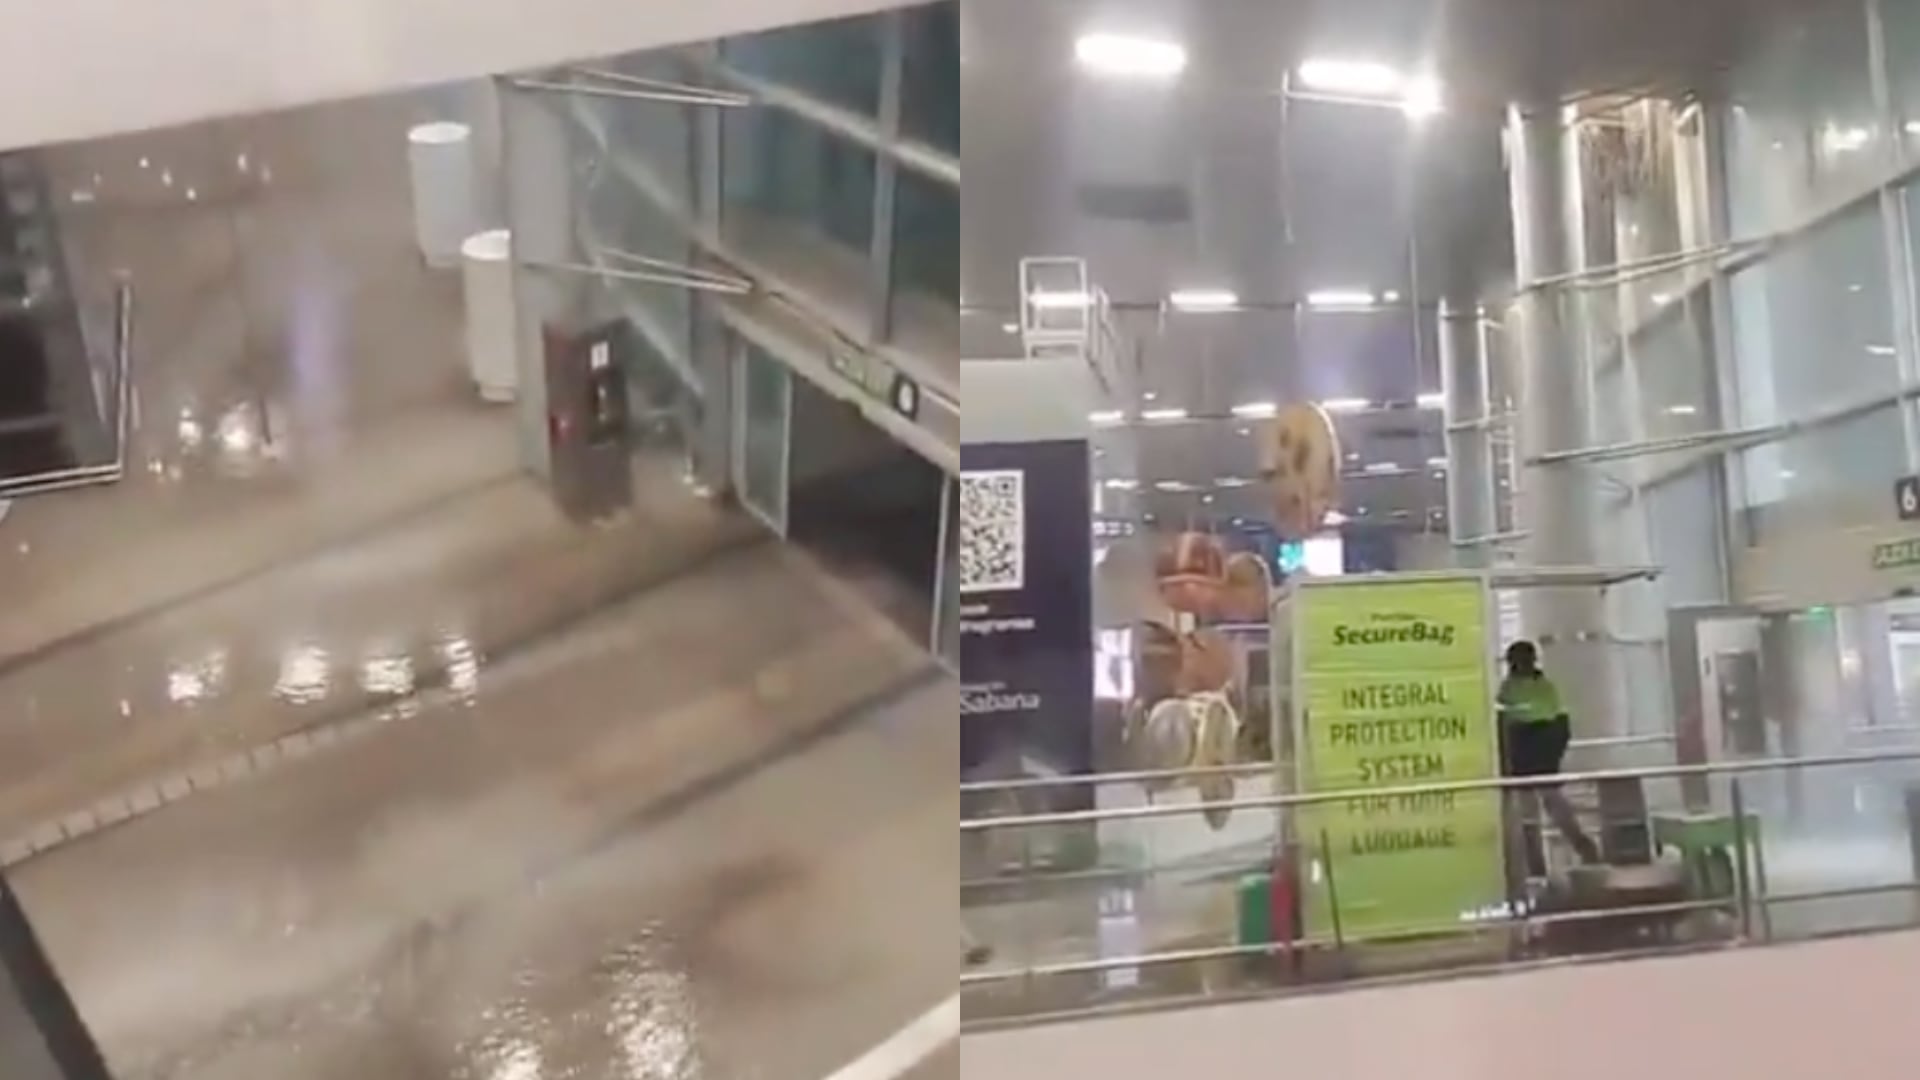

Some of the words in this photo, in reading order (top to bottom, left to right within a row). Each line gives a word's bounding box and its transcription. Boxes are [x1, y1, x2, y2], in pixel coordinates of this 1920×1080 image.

[1902, 485, 1917, 512] 6
[1332, 622, 1455, 646] SecureBag
[1342, 682, 1448, 710] INTEGRAL
[1330, 715, 1467, 746] PROTECTION
[1357, 752, 1444, 782] SYSTEM
